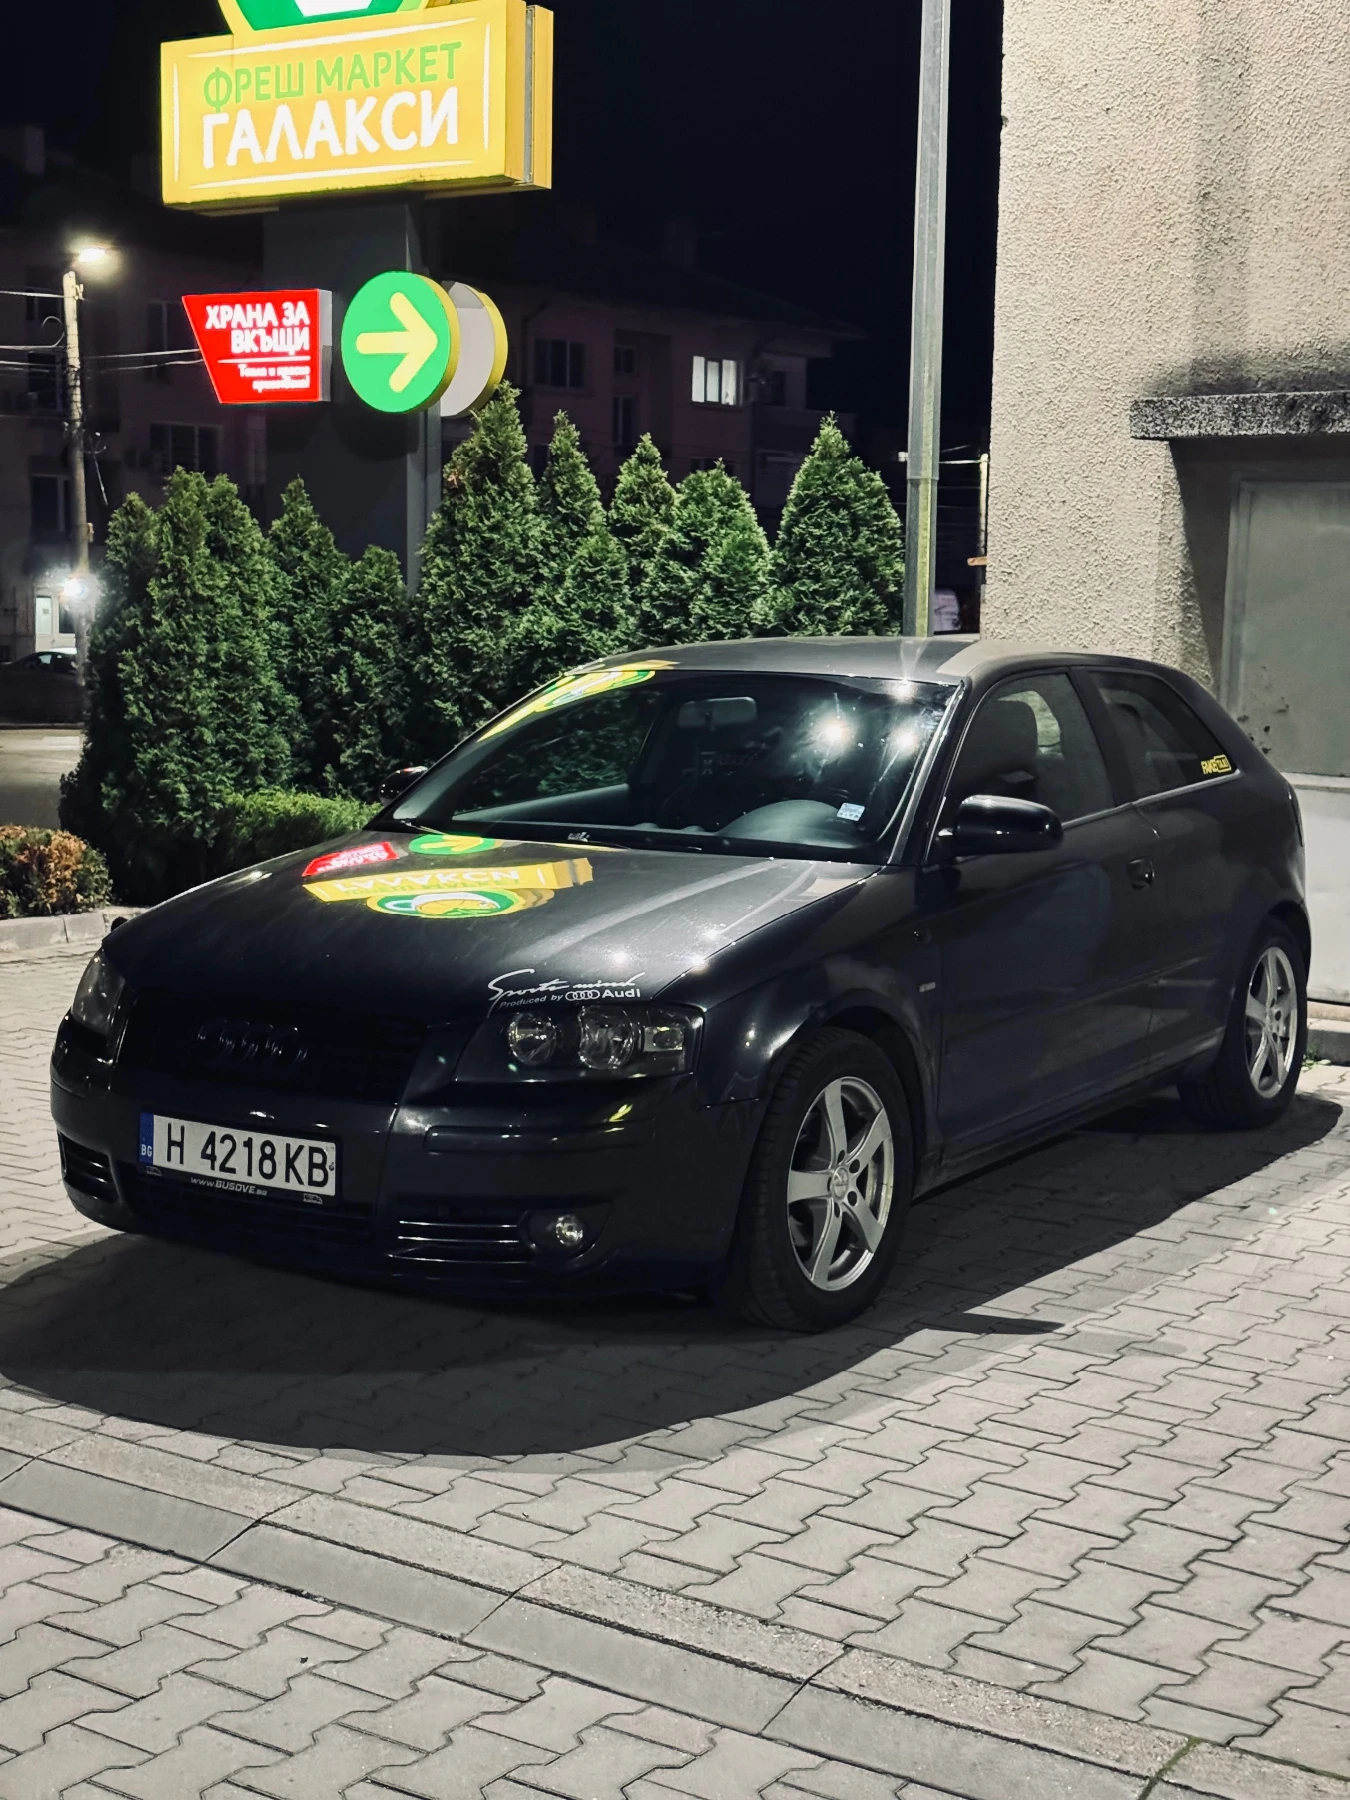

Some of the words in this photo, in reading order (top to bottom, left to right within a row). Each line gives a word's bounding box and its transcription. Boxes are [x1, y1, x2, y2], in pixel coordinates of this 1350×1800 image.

[203, 61, 304, 113] ФРЕШ
[316, 41, 463, 94] МАРКЕТ
[202, 86, 459, 169] ГАЛАКСИ
[205, 304, 278, 330] ХРАНА
[282, 301, 310, 326] ЗА
[231, 326, 310, 356] ВКЪЩИ
[500, 995, 547, 1009] Produced
[551, 993, 564, 1002] by
[602, 988, 641, 998] Audi
[141, 1143, 153, 1157] BG
[166, 1122, 185, 1165] H
[200, 1131, 277, 1180] 4218
